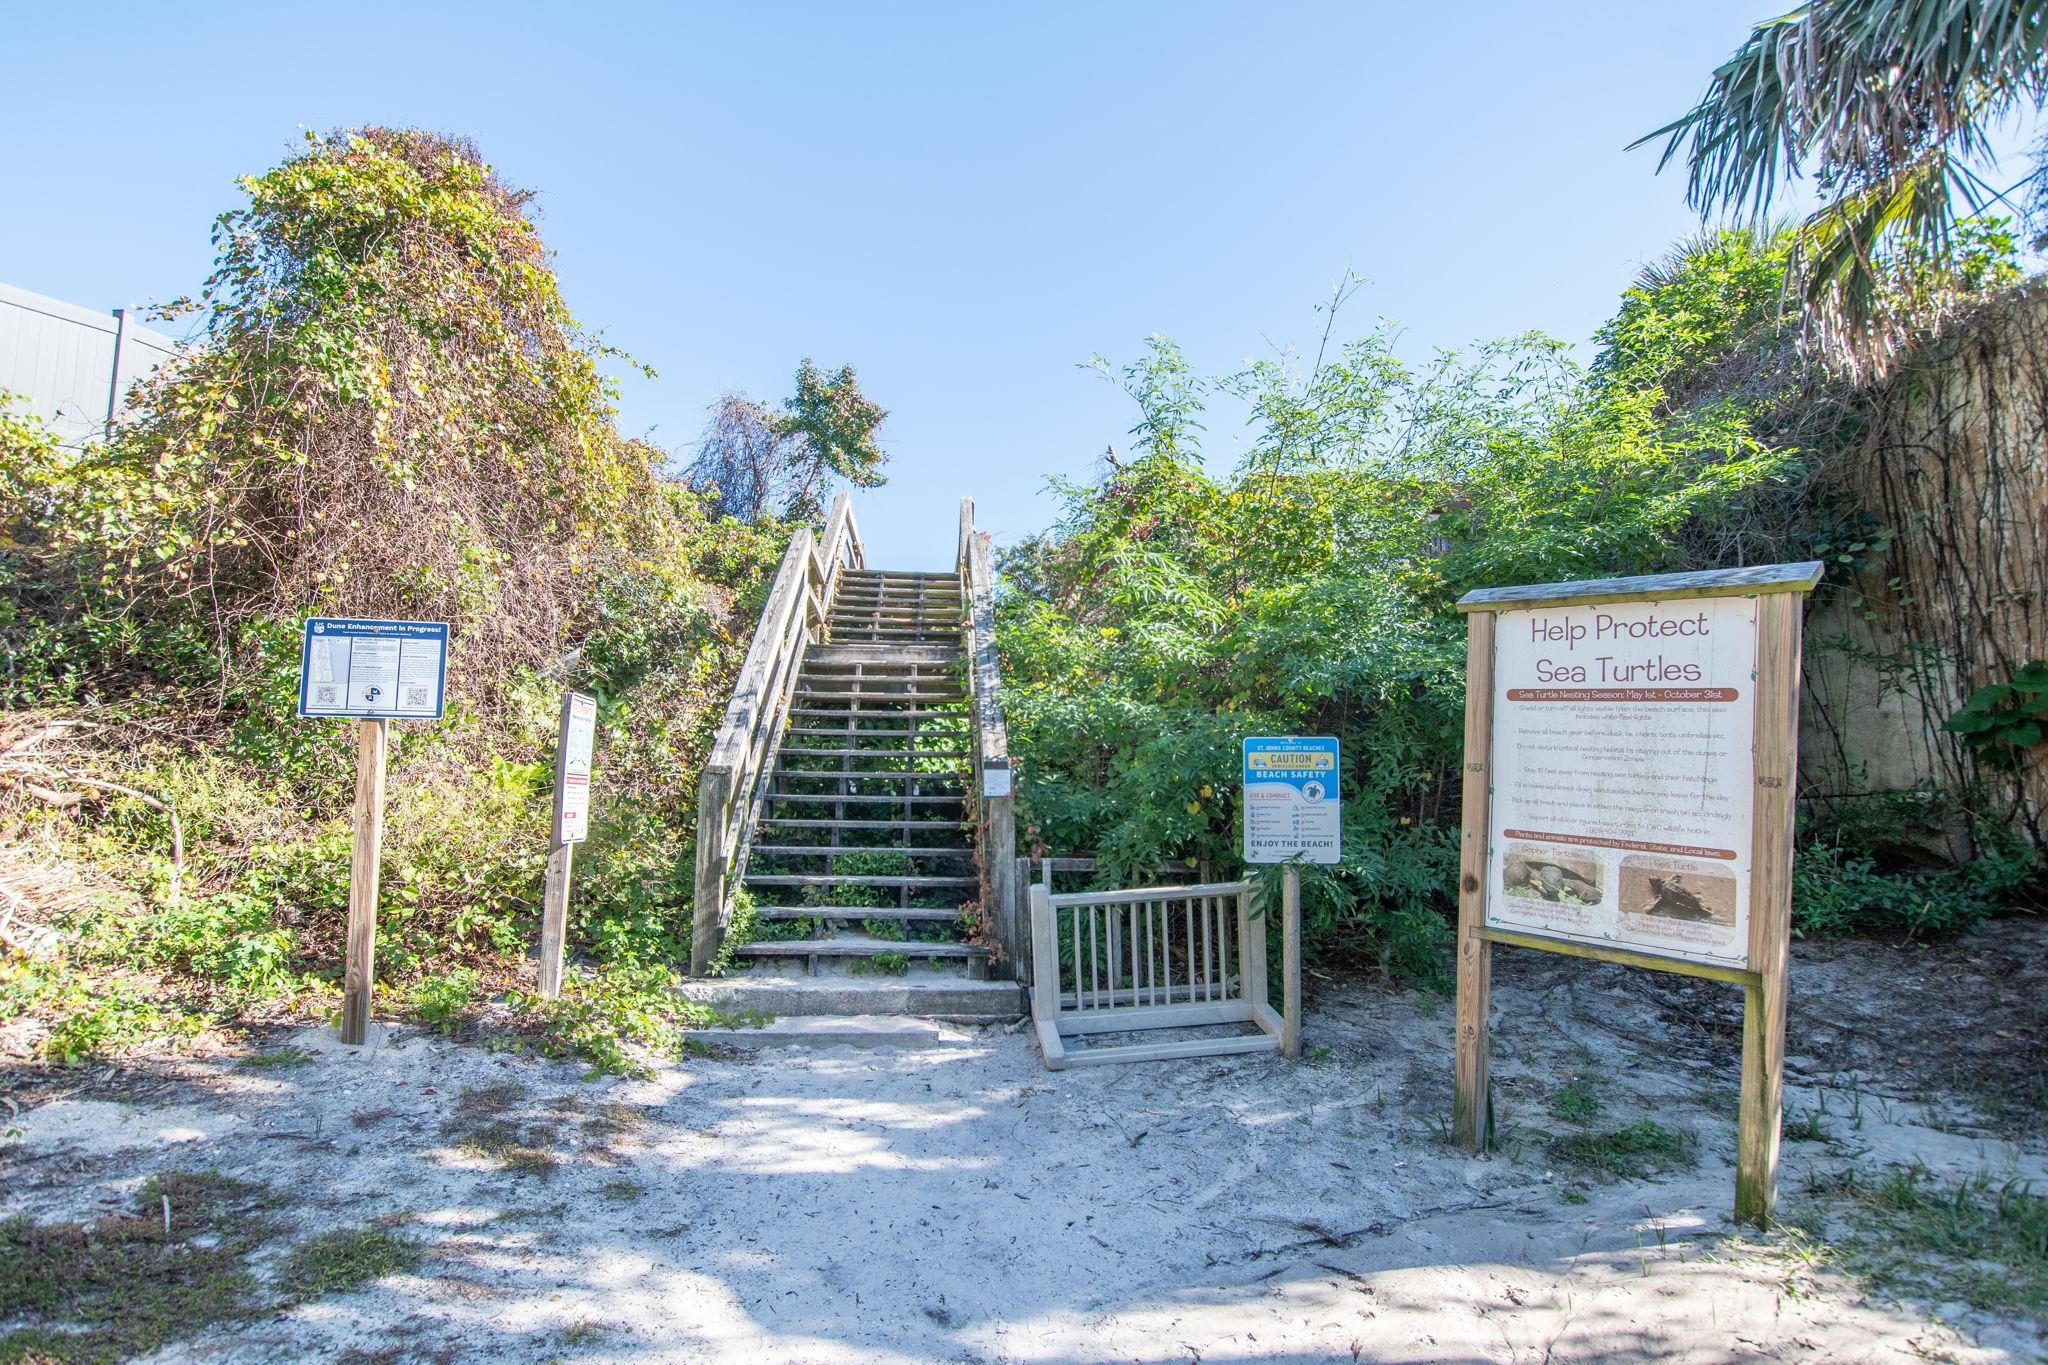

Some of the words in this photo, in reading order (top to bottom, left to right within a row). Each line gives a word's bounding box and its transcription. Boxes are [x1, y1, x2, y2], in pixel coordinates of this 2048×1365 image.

[408, 625, 442, 634] Progress!
[1532, 616, 1587, 651] Help
[1596, 612, 1710, 640] Protect
[1536, 659, 1586, 682] Sea
[1595, 655, 1702, 682] Turtles
[1519, 691, 1534, 699] Sea
[1536, 691, 1558, 699] Turtle
[1560, 691, 1590, 701] Nesting
[1592, 691, 1625, 699] Season:
[1627, 691, 1642, 701] May
[1664, 690, 1702, 699] October
[1704, 691, 1723, 699] 31st
[1270, 754, 1312, 764] CAUTION
[1251, 840, 1280, 848] ENJOY
[1281, 840, 1299, 848] THE
[1300, 840, 1334, 848] BEACH!
[1579, 836, 1612, 846] protected
[1612, 838, 1620, 847] by
[1684, 847, 1703, 855] Local
[1521, 846, 1550, 857] Gopher
[1672, 861, 1698, 872] Turtle
